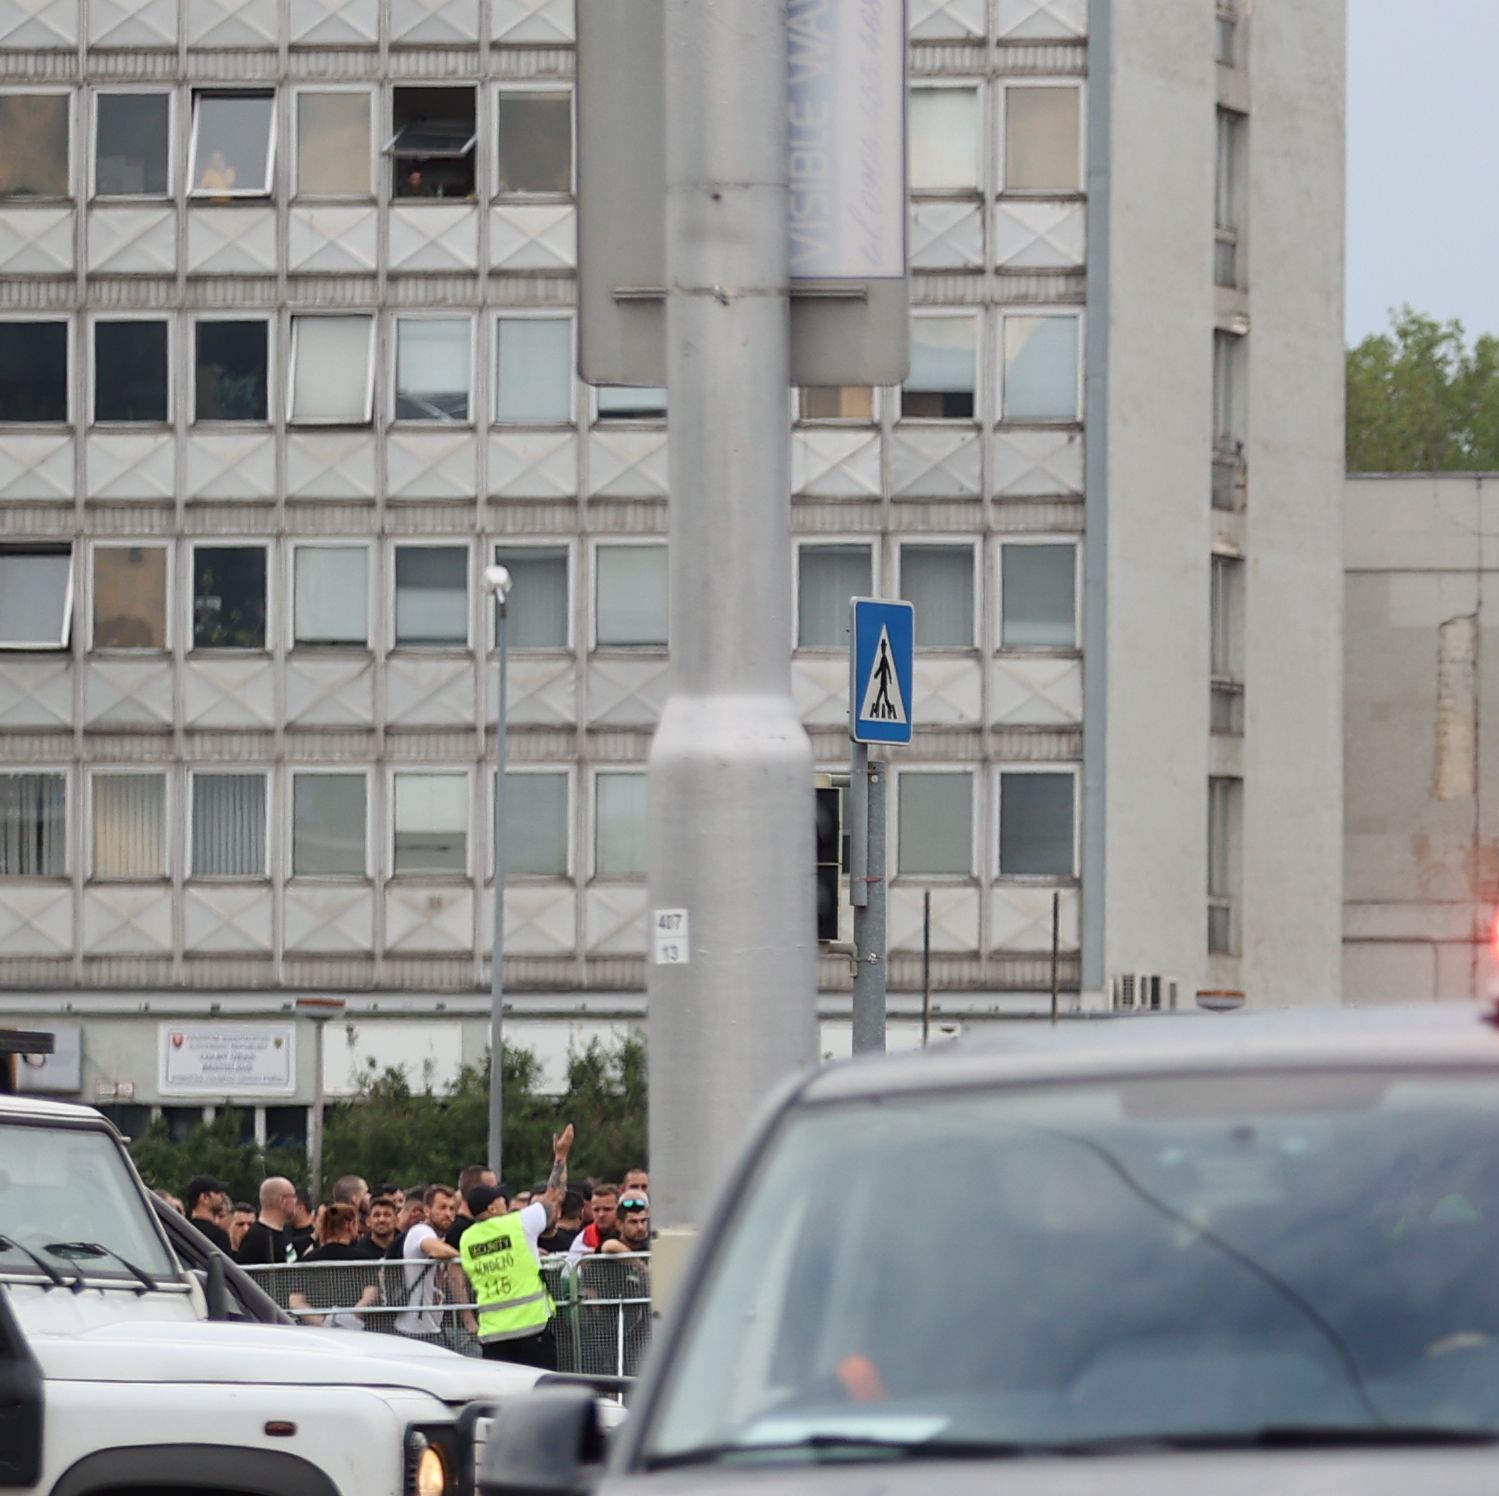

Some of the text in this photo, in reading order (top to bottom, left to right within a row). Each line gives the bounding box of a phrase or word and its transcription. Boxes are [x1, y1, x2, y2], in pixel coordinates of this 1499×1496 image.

[789, 0, 832, 267] VISIBLE WA
[663, 945, 679, 961] 13
